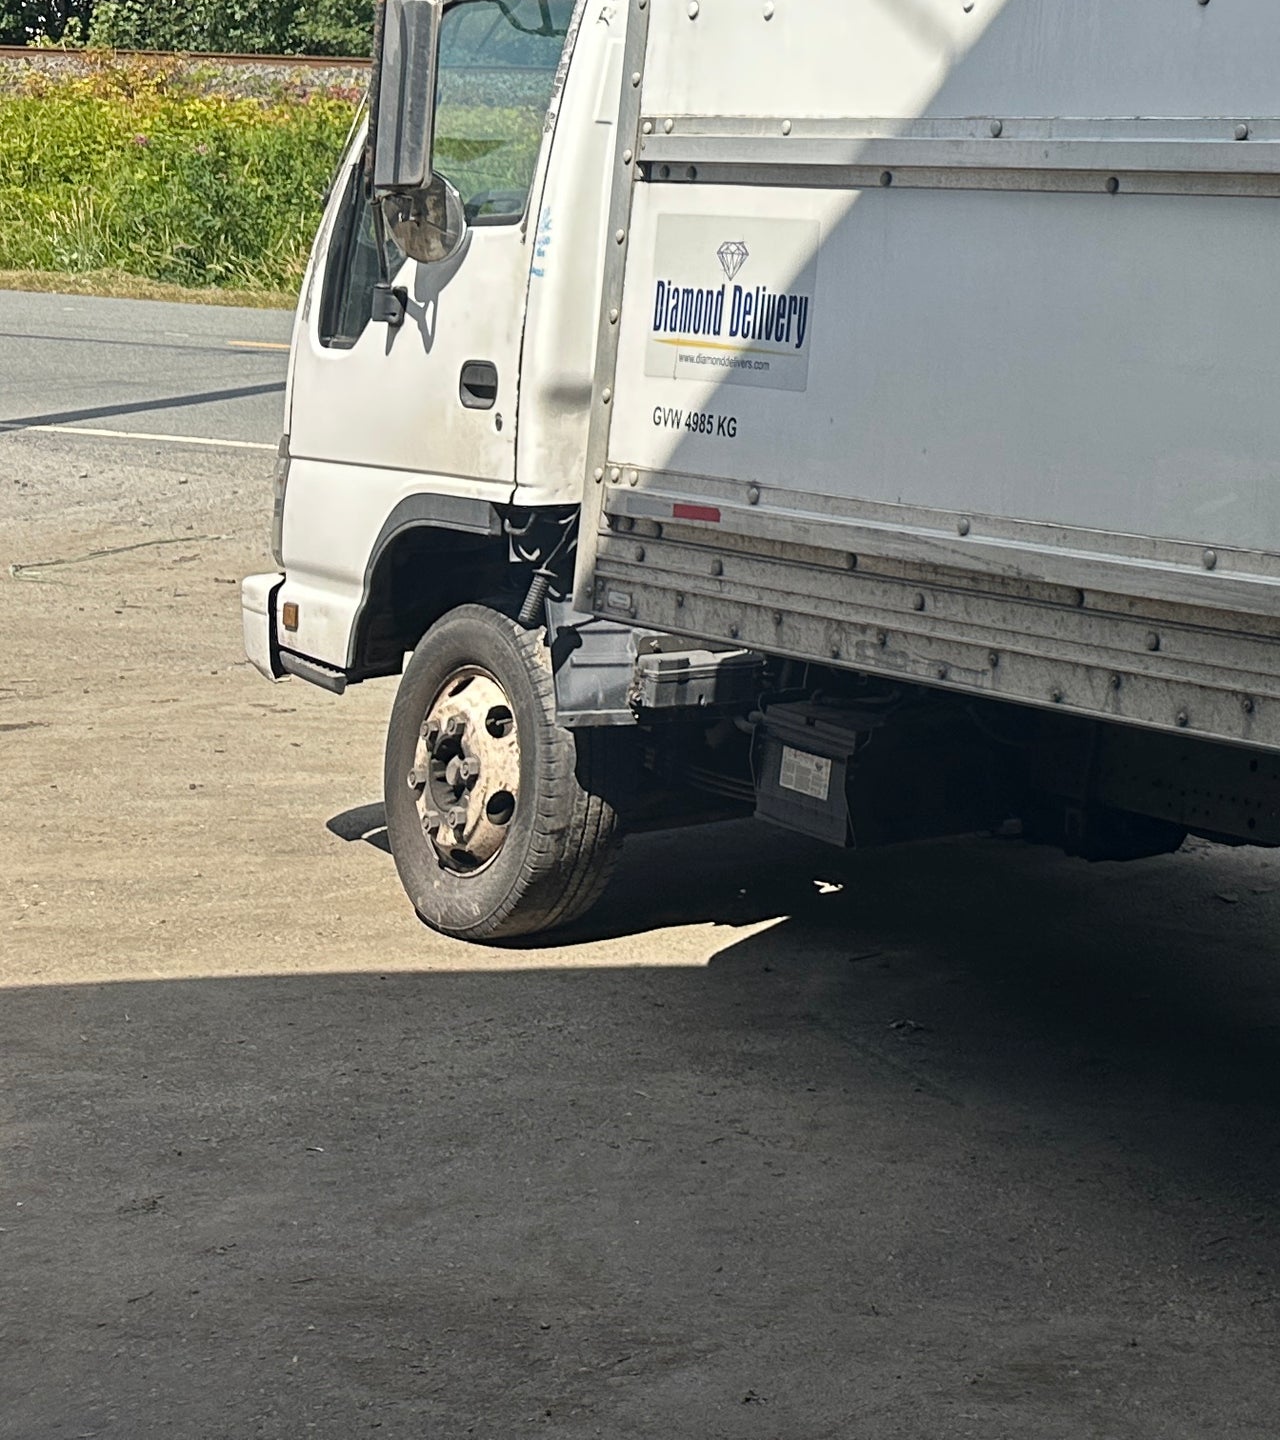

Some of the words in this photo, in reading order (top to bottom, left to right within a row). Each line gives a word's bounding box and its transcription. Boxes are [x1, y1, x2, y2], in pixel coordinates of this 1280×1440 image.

[653, 280, 725, 335] Diamond
[729, 284, 809, 348] Delivery
[652, 406, 683, 429] GVW
[685, 410, 714, 435] 4985
[717, 414, 738, 438] KG
